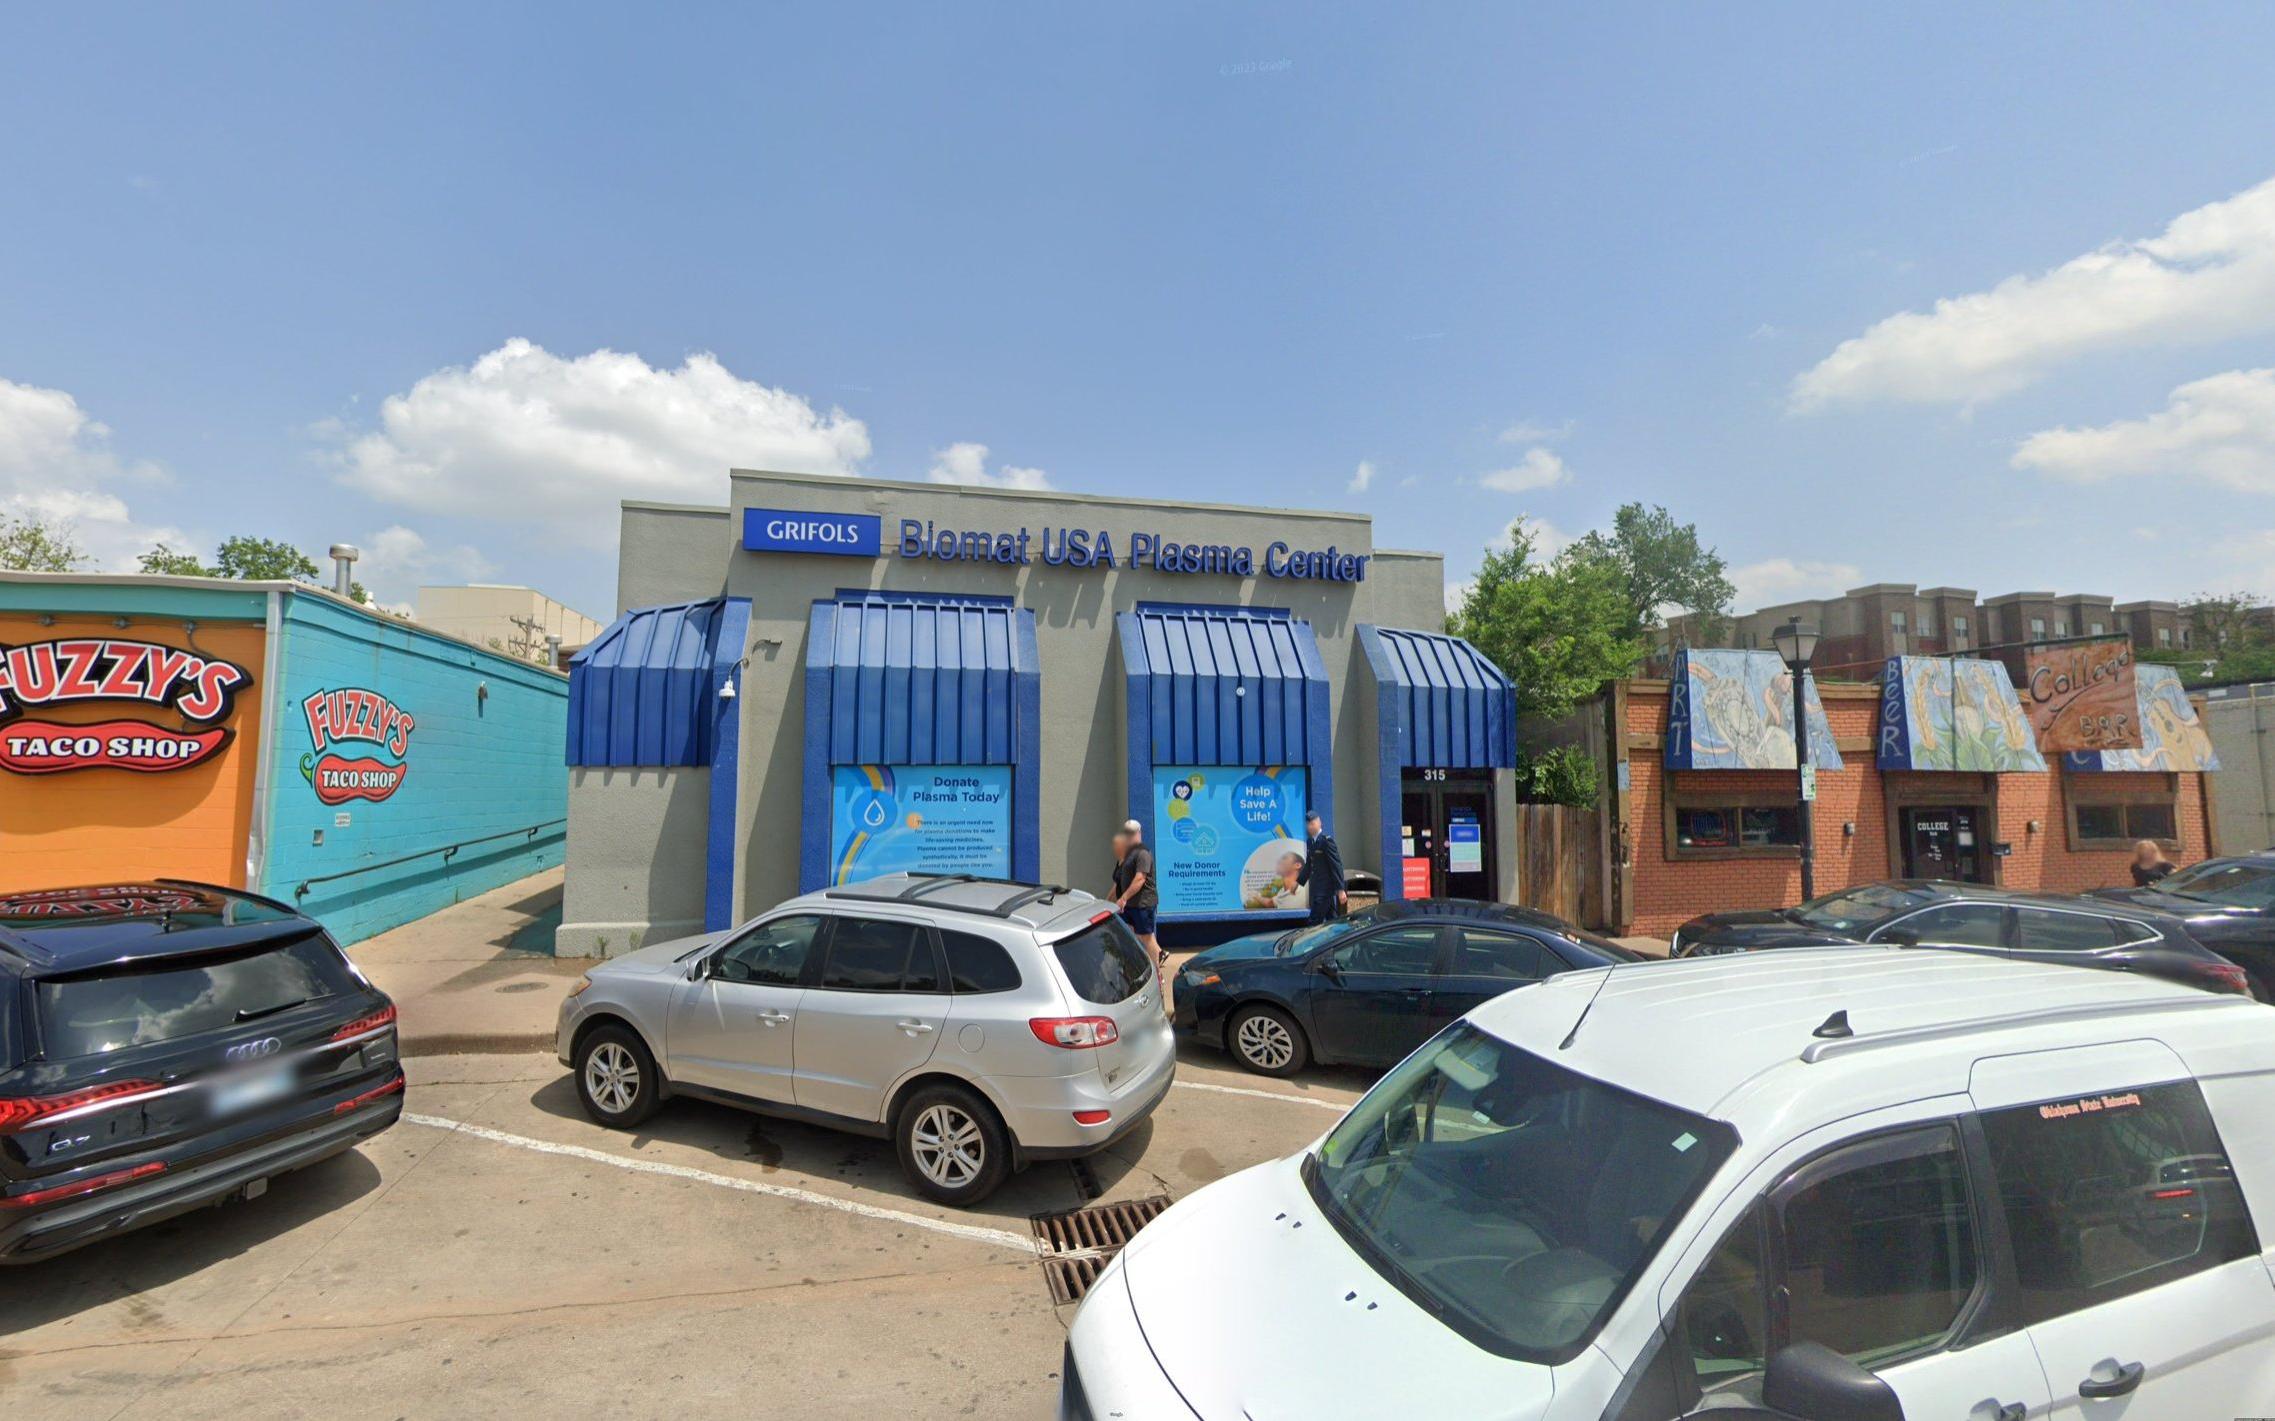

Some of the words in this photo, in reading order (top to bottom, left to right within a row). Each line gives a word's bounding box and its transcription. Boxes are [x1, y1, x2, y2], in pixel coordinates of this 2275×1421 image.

[767, 520, 859, 544] GRIFOLS
[900, 519, 1031, 565] Biomat
[1042, 527, 1117, 569] USA
[1130, 532, 1255, 577] Plasma
[1266, 541, 1371, 582] Center
[2031, 650, 2130, 703] College
[303, 688, 414, 757] FUZZY'S
[7, 738, 100, 757] TACO
[107, 738, 201, 758] SHOP
[322, 770, 359, 788] TACO
[361, 771, 397, 788] SHOP
[1424, 769, 1446, 781] 315
[933, 776, 980, 788] Donate
[913, 791, 958, 802] Plasma
[962, 791, 1000, 804] Today
[1245, 786, 1271, 798] Help
[1239, 799, 1266, 809] Save
[1269, 799, 1277, 809] A
[1247, 811, 1271, 822] Life!
[1917, 821, 1950, 831] COLLEGE
[1173, 862, 1193, 870] New
[1194, 861, 1221, 870] Donor
[1168, 870, 1226, 879] Requirements
[51, 1134, 91, 1152] Q7
